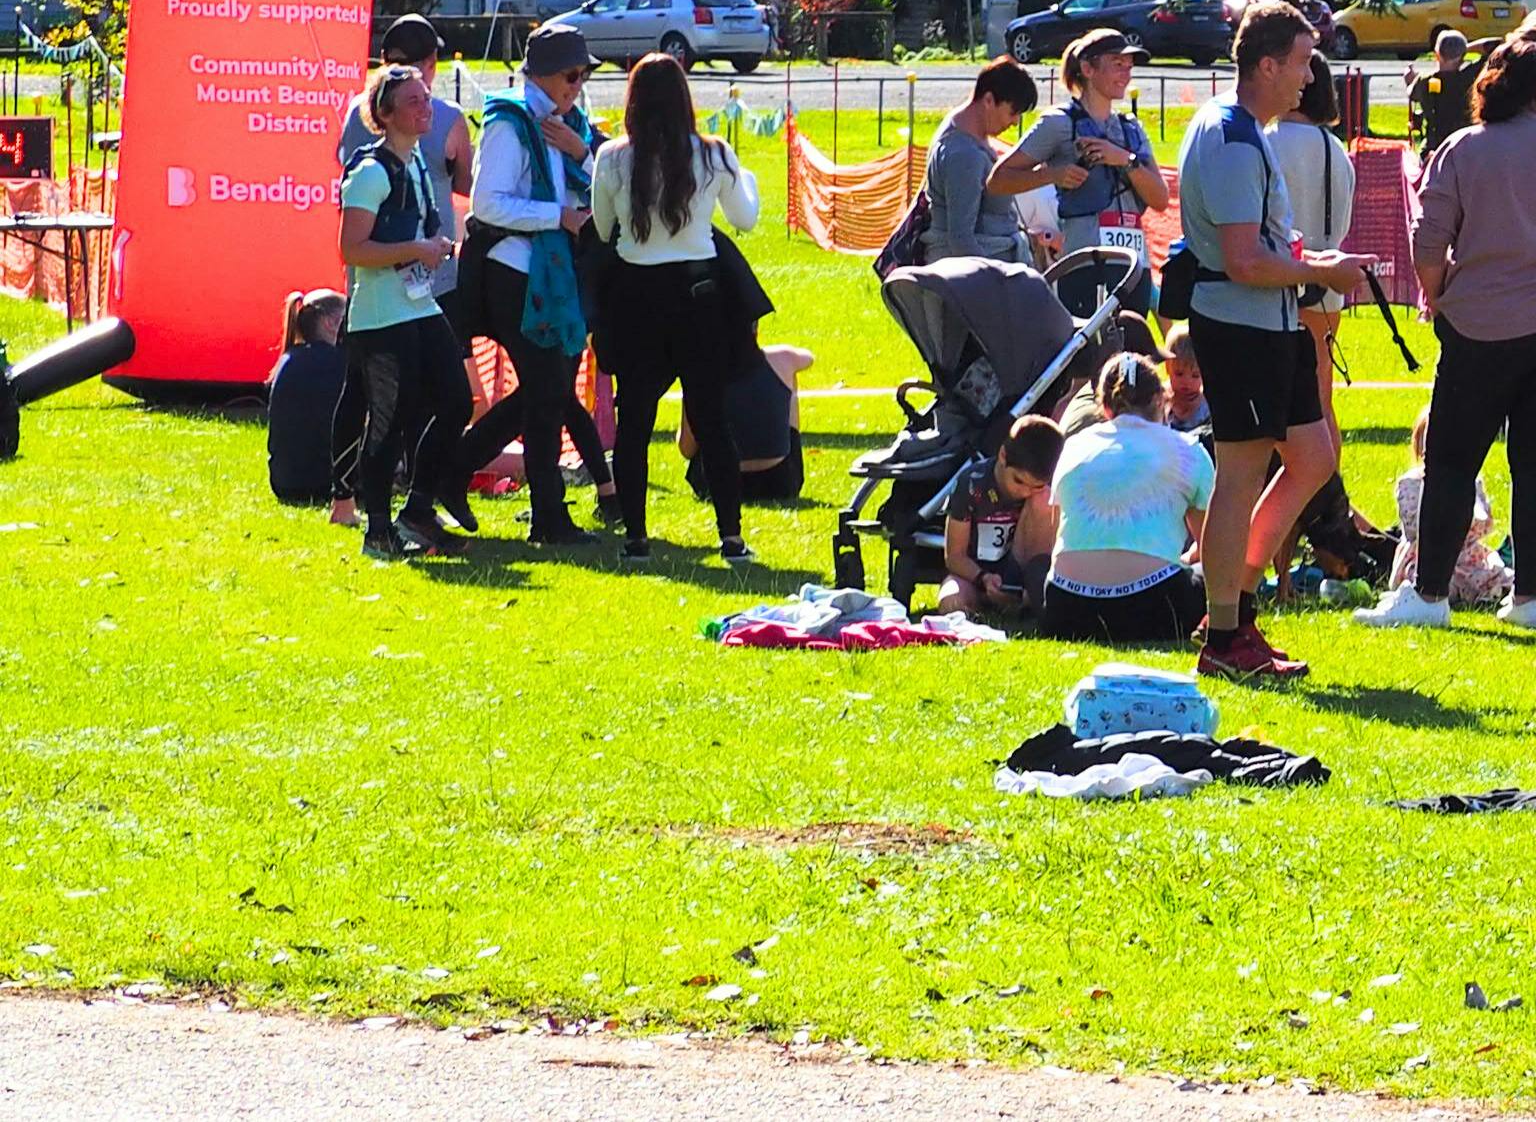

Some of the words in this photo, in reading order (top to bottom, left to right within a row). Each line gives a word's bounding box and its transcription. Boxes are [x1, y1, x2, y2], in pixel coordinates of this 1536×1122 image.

[258, 0, 358, 24] supported
[190, 54, 319, 80] Community
[324, 59, 361, 79] Bank
[197, 84, 271, 103] Mount
[278, 85, 345, 109] Beauty
[248, 113, 328, 134] District
[210, 174, 326, 210] Bendigo
[1115, 583, 1136, 595] NOT
[1139, 569, 1169, 588] TODAY
